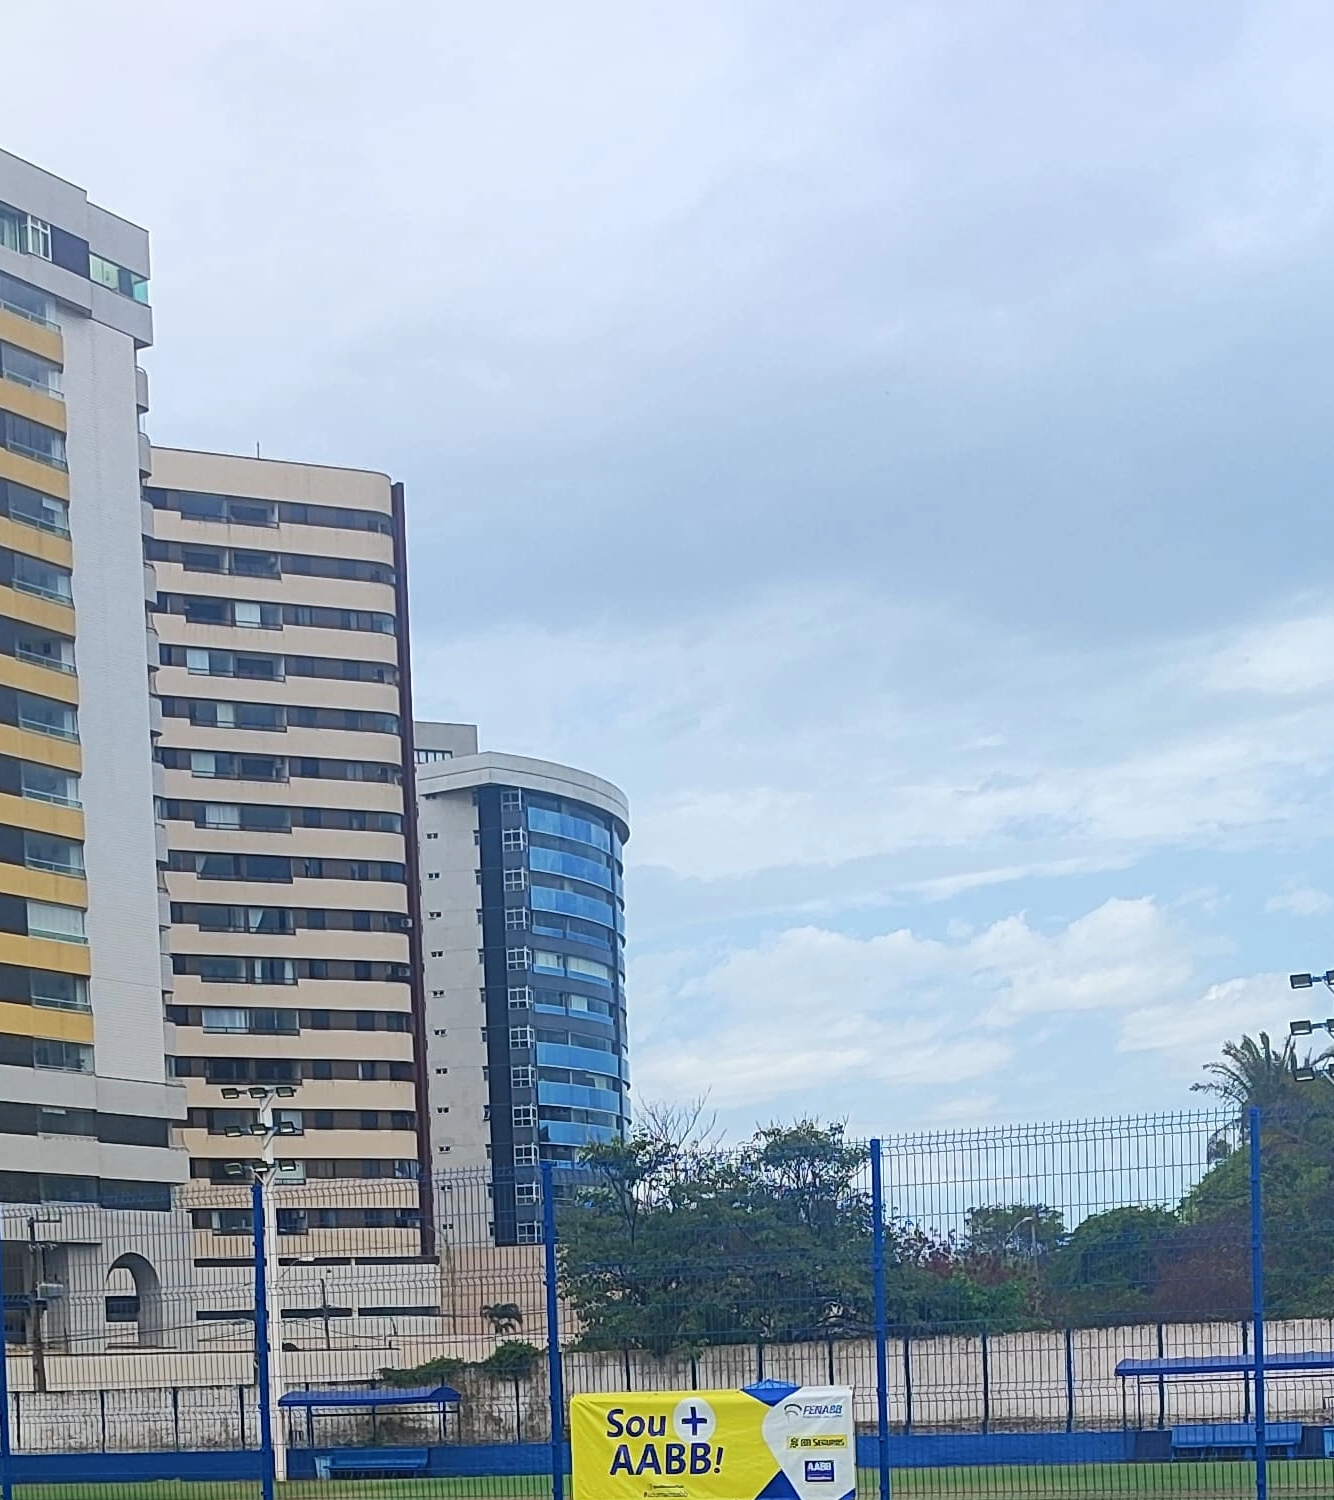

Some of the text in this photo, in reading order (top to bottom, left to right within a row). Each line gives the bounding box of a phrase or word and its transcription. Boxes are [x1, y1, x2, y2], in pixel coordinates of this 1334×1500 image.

[606, 1406, 708, 1438] Sou +
[609, 1443, 724, 1476] AABB!
[807, 1461, 833, 1471] AABB
